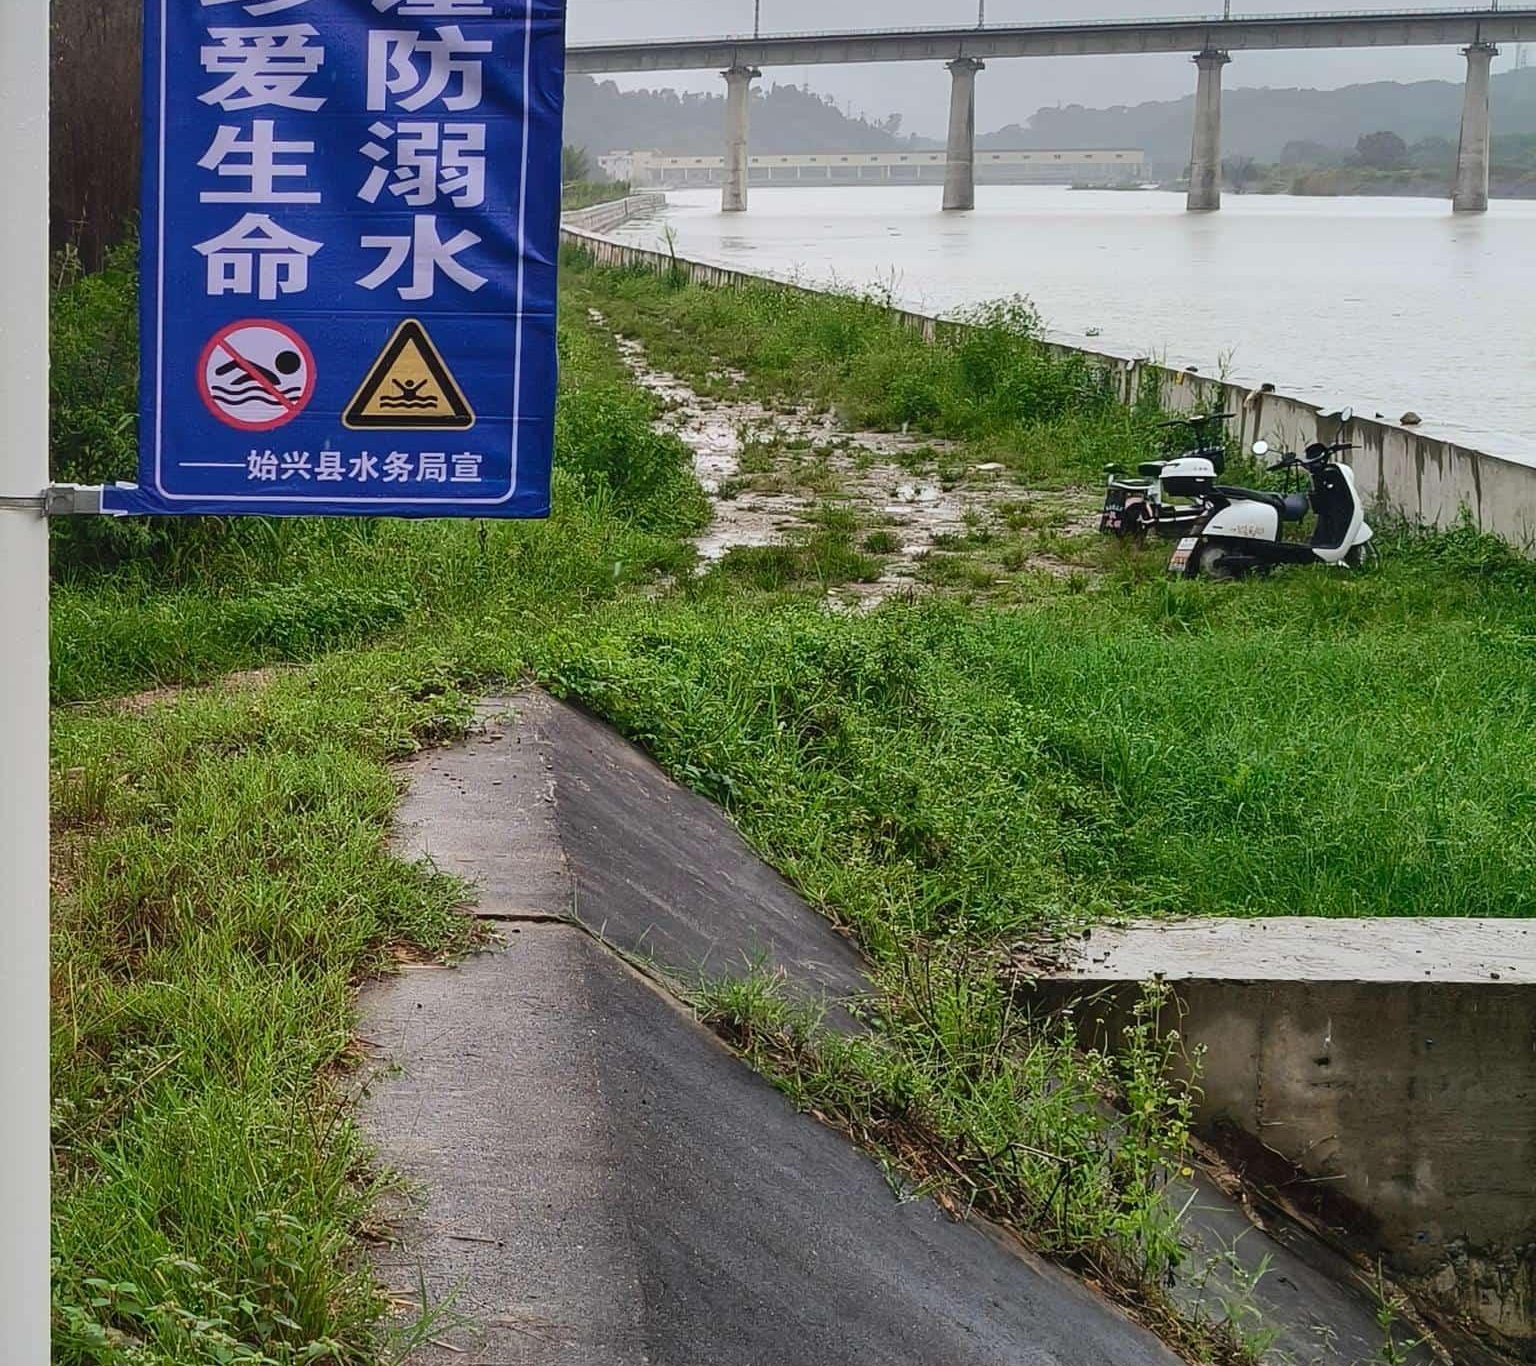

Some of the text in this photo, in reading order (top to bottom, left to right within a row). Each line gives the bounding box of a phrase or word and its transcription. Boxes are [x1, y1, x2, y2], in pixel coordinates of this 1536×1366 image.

[246, 448, 483, 483] 始兴县水务局宣
